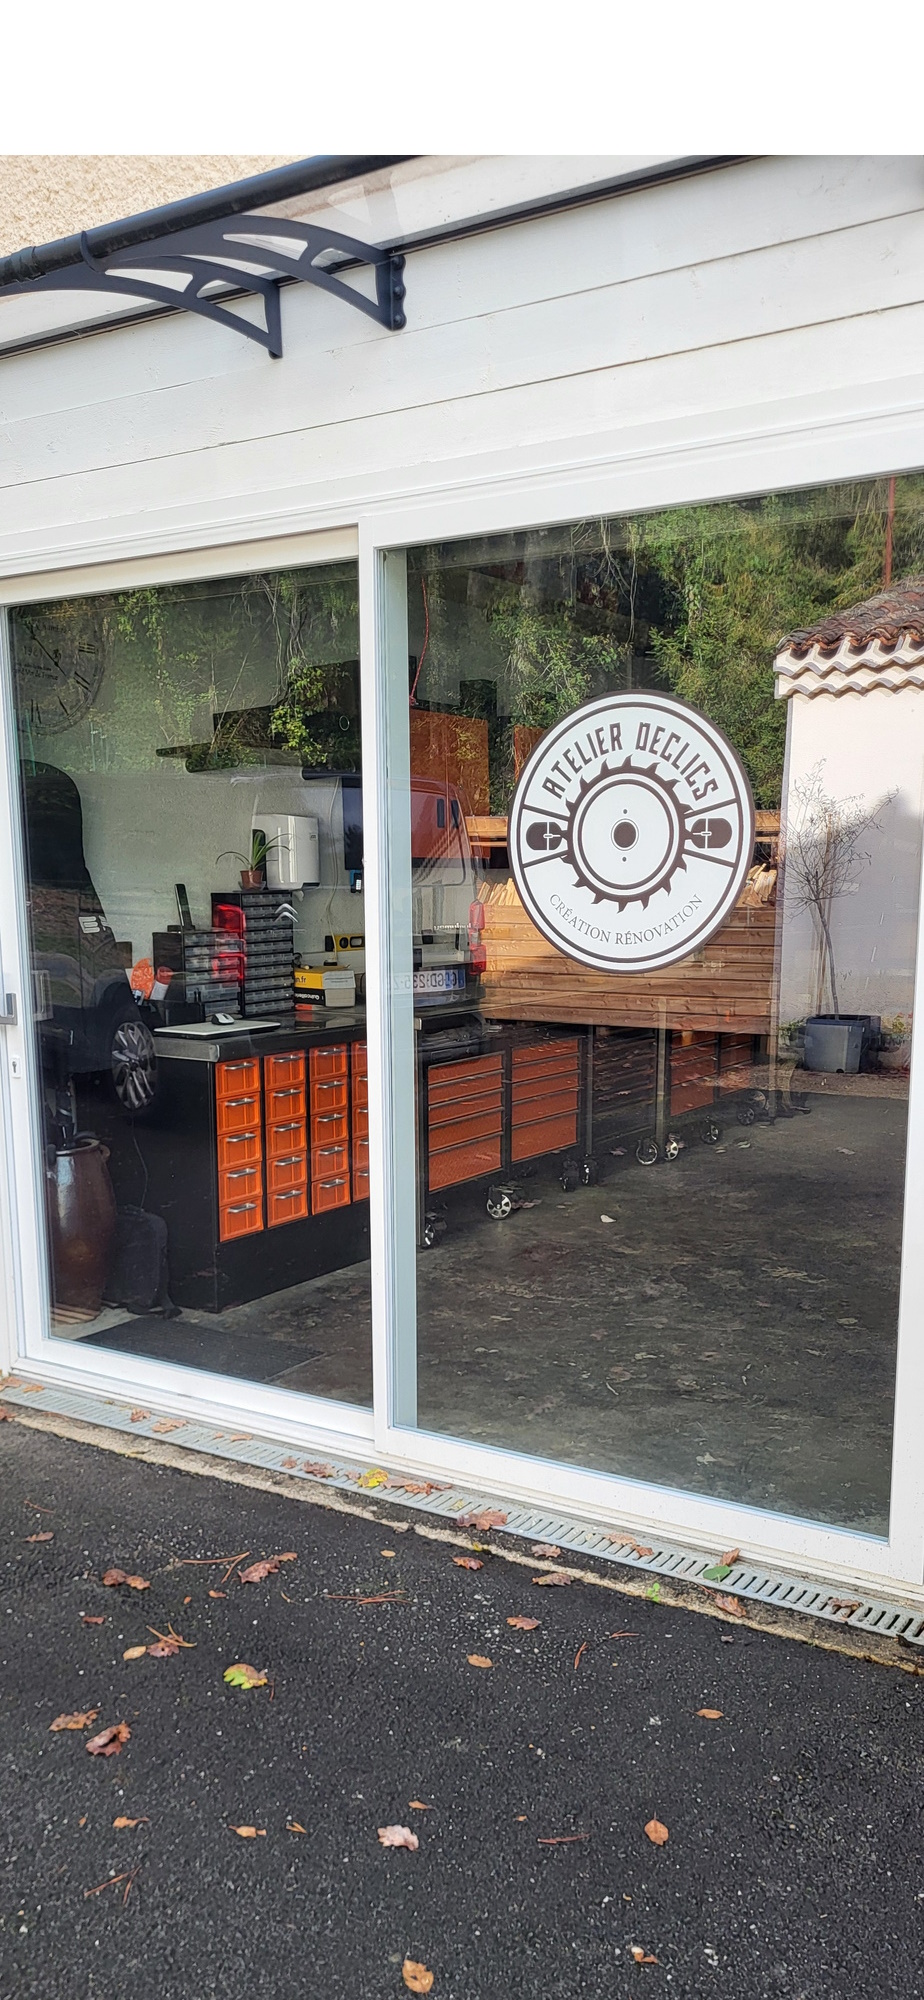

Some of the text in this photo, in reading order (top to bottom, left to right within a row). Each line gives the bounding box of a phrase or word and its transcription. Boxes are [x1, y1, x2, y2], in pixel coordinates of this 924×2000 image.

[541, 722, 719, 801] ATELIER DECLICS
[550, 894, 703, 945] CRÉATION RÉNOVATION
